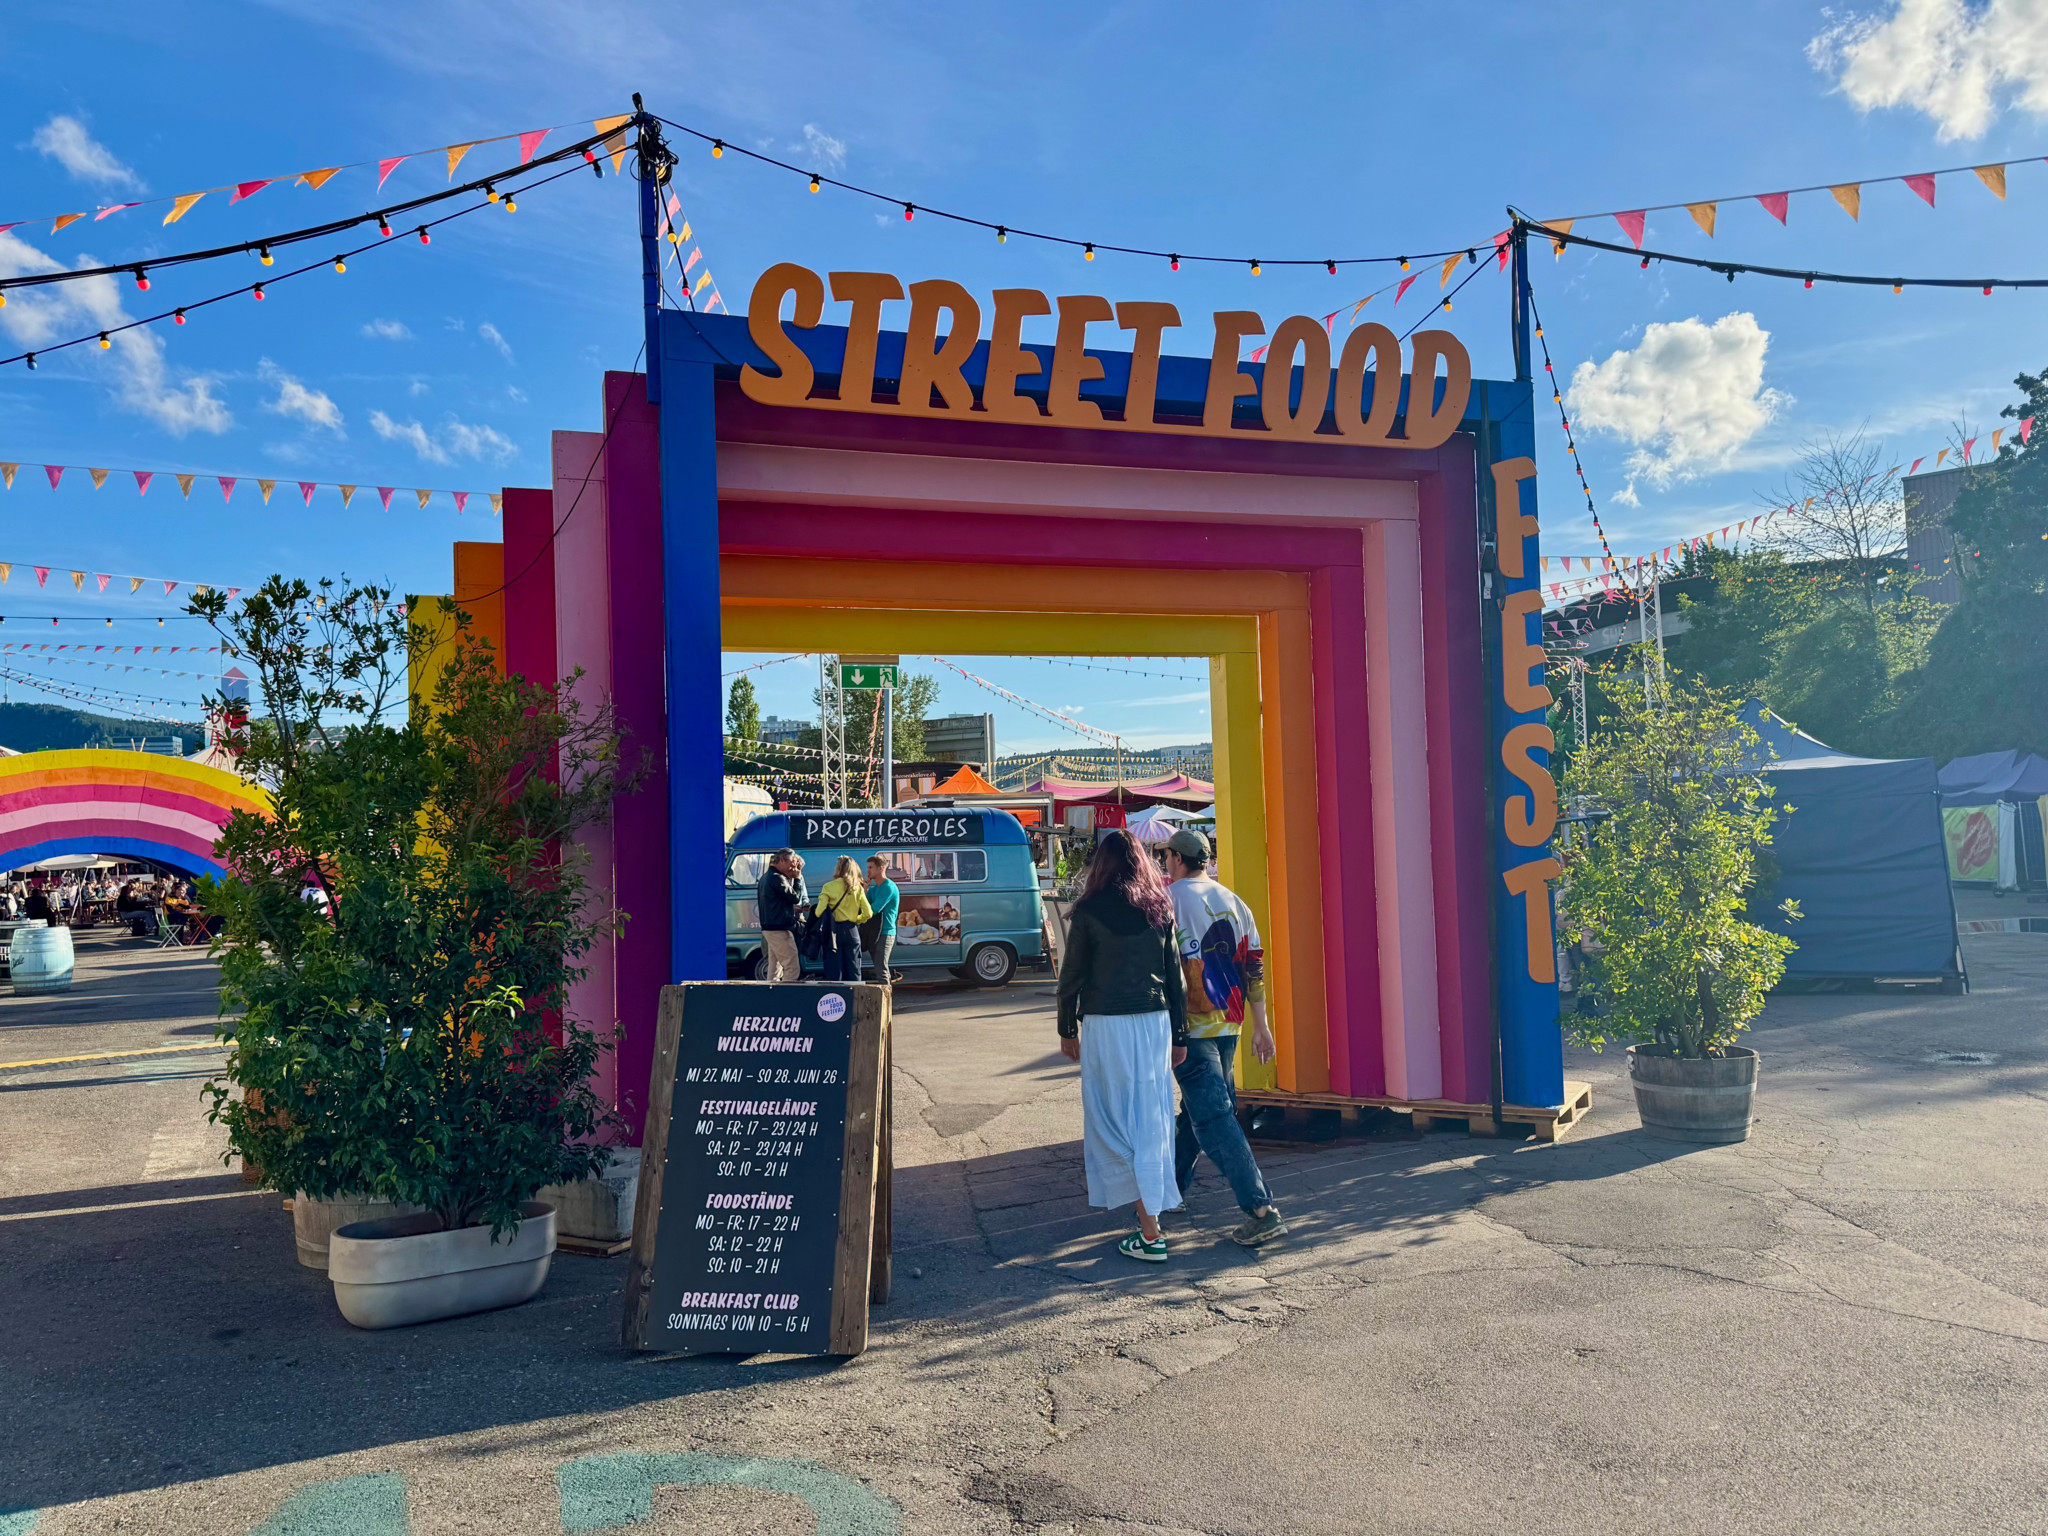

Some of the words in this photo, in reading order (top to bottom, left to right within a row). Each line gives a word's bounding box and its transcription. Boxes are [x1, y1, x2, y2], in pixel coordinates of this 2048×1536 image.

[739, 262, 1182, 423] STREET
[1203, 310, 1472, 449] FOOD
[1491, 456, 1562, 984] FEST
[807, 818, 967, 840] PROFITEROLES
[874, 835, 896, 843] Lindt
[820, 997, 837, 1006] STREET
[821, 1007, 844, 1017] FESTIVAL
[732, 1016, 802, 1032] HERZLICH
[717, 1036, 813, 1052] WILLKOMMEN
[686, 1068, 701, 1082] MI
[703, 1068, 717, 1082] 27.
[720, 1069, 743, 1083] MAI
[757, 1069, 772, 1083] SO
[774, 1069, 791, 1083] 28.
[793, 1069, 820, 1083] JUNI
[823, 1070, 837, 1083] 26
[700, 1099, 817, 1116] FESTIVALGELÄNDE
[695, 1120, 713, 1134] MO
[726, 1121, 743, 1135] FR:
[747, 1121, 759, 1135] 17
[809, 1122, 818, 1136] H
[706, 1141, 724, 1155] SA:
[728, 1141, 740, 1155] 12
[794, 1142, 803, 1156] H
[717, 1161, 736, 1176] SO:
[739, 1161, 751, 1176] 10
[764, 1162, 776, 1176] 21
[779, 1162, 788, 1177] H
[705, 1191, 794, 1209] FOODSTÄNDE
[695, 1215, 714, 1230] MO
[727, 1215, 744, 1230] FR:
[748, 1215, 760, 1230] 17
[773, 1216, 788, 1231] 22
[790, 1216, 800, 1231] H
[708, 1236, 727, 1251] SA:
[731, 1236, 743, 1251] 12
[756, 1237, 771, 1252] 22
[774, 1237, 783, 1252] H
[707, 1257, 726, 1273] SO:
[730, 1258, 742, 1273] 10
[755, 1258, 768, 1274] 21
[770, 1258, 780, 1274] H
[681, 1292, 761, 1309] BREAKFAST
[764, 1294, 799, 1310] CLUB
[667, 1313, 728, 1330] SONNTAGS
[731, 1315, 755, 1331] VON
[759, 1315, 771, 1332] 10
[786, 1316, 798, 1332] 15
[800, 1316, 810, 1332] H
